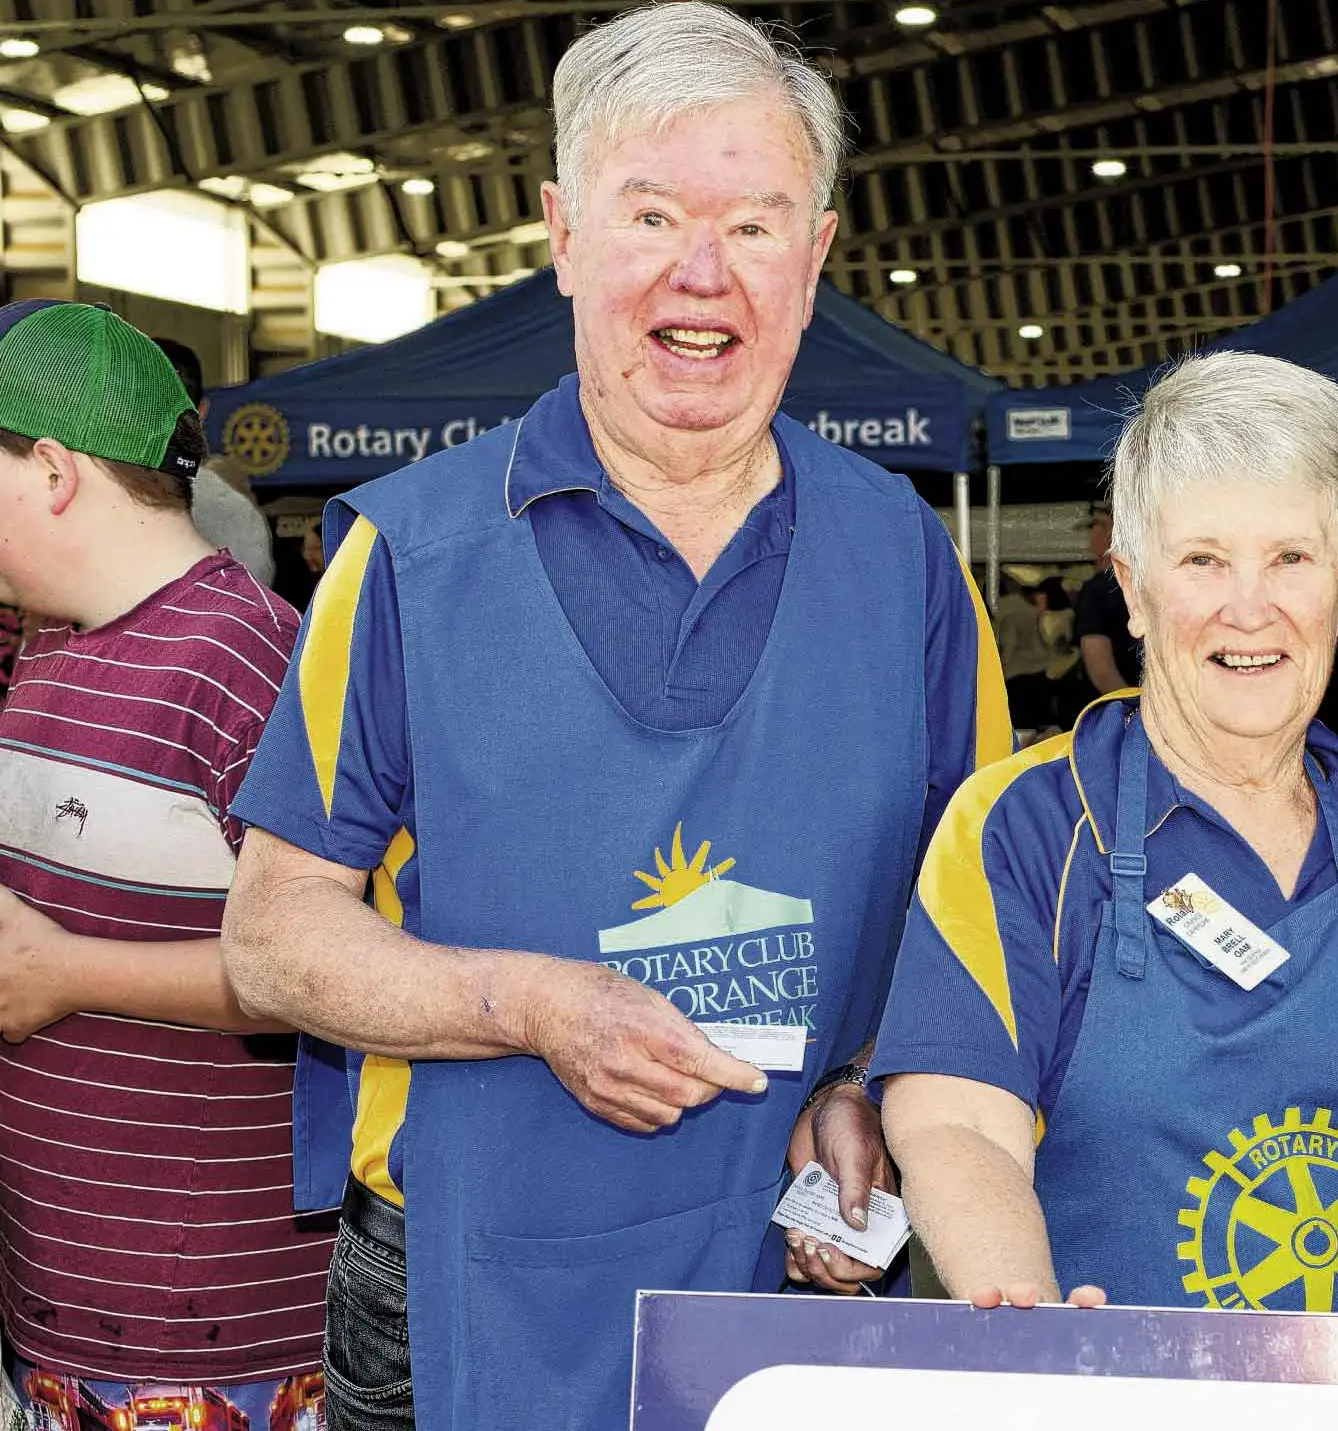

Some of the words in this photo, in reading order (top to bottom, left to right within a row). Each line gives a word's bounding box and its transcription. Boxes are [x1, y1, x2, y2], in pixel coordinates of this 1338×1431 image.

[308, 422, 431, 462] Rotary
[736, 930, 815, 969] CLUB
[1213, 926, 1234, 946] MARY
[1221, 934, 1248, 955] BRELL
[667, 965, 820, 1019] ORANGE
